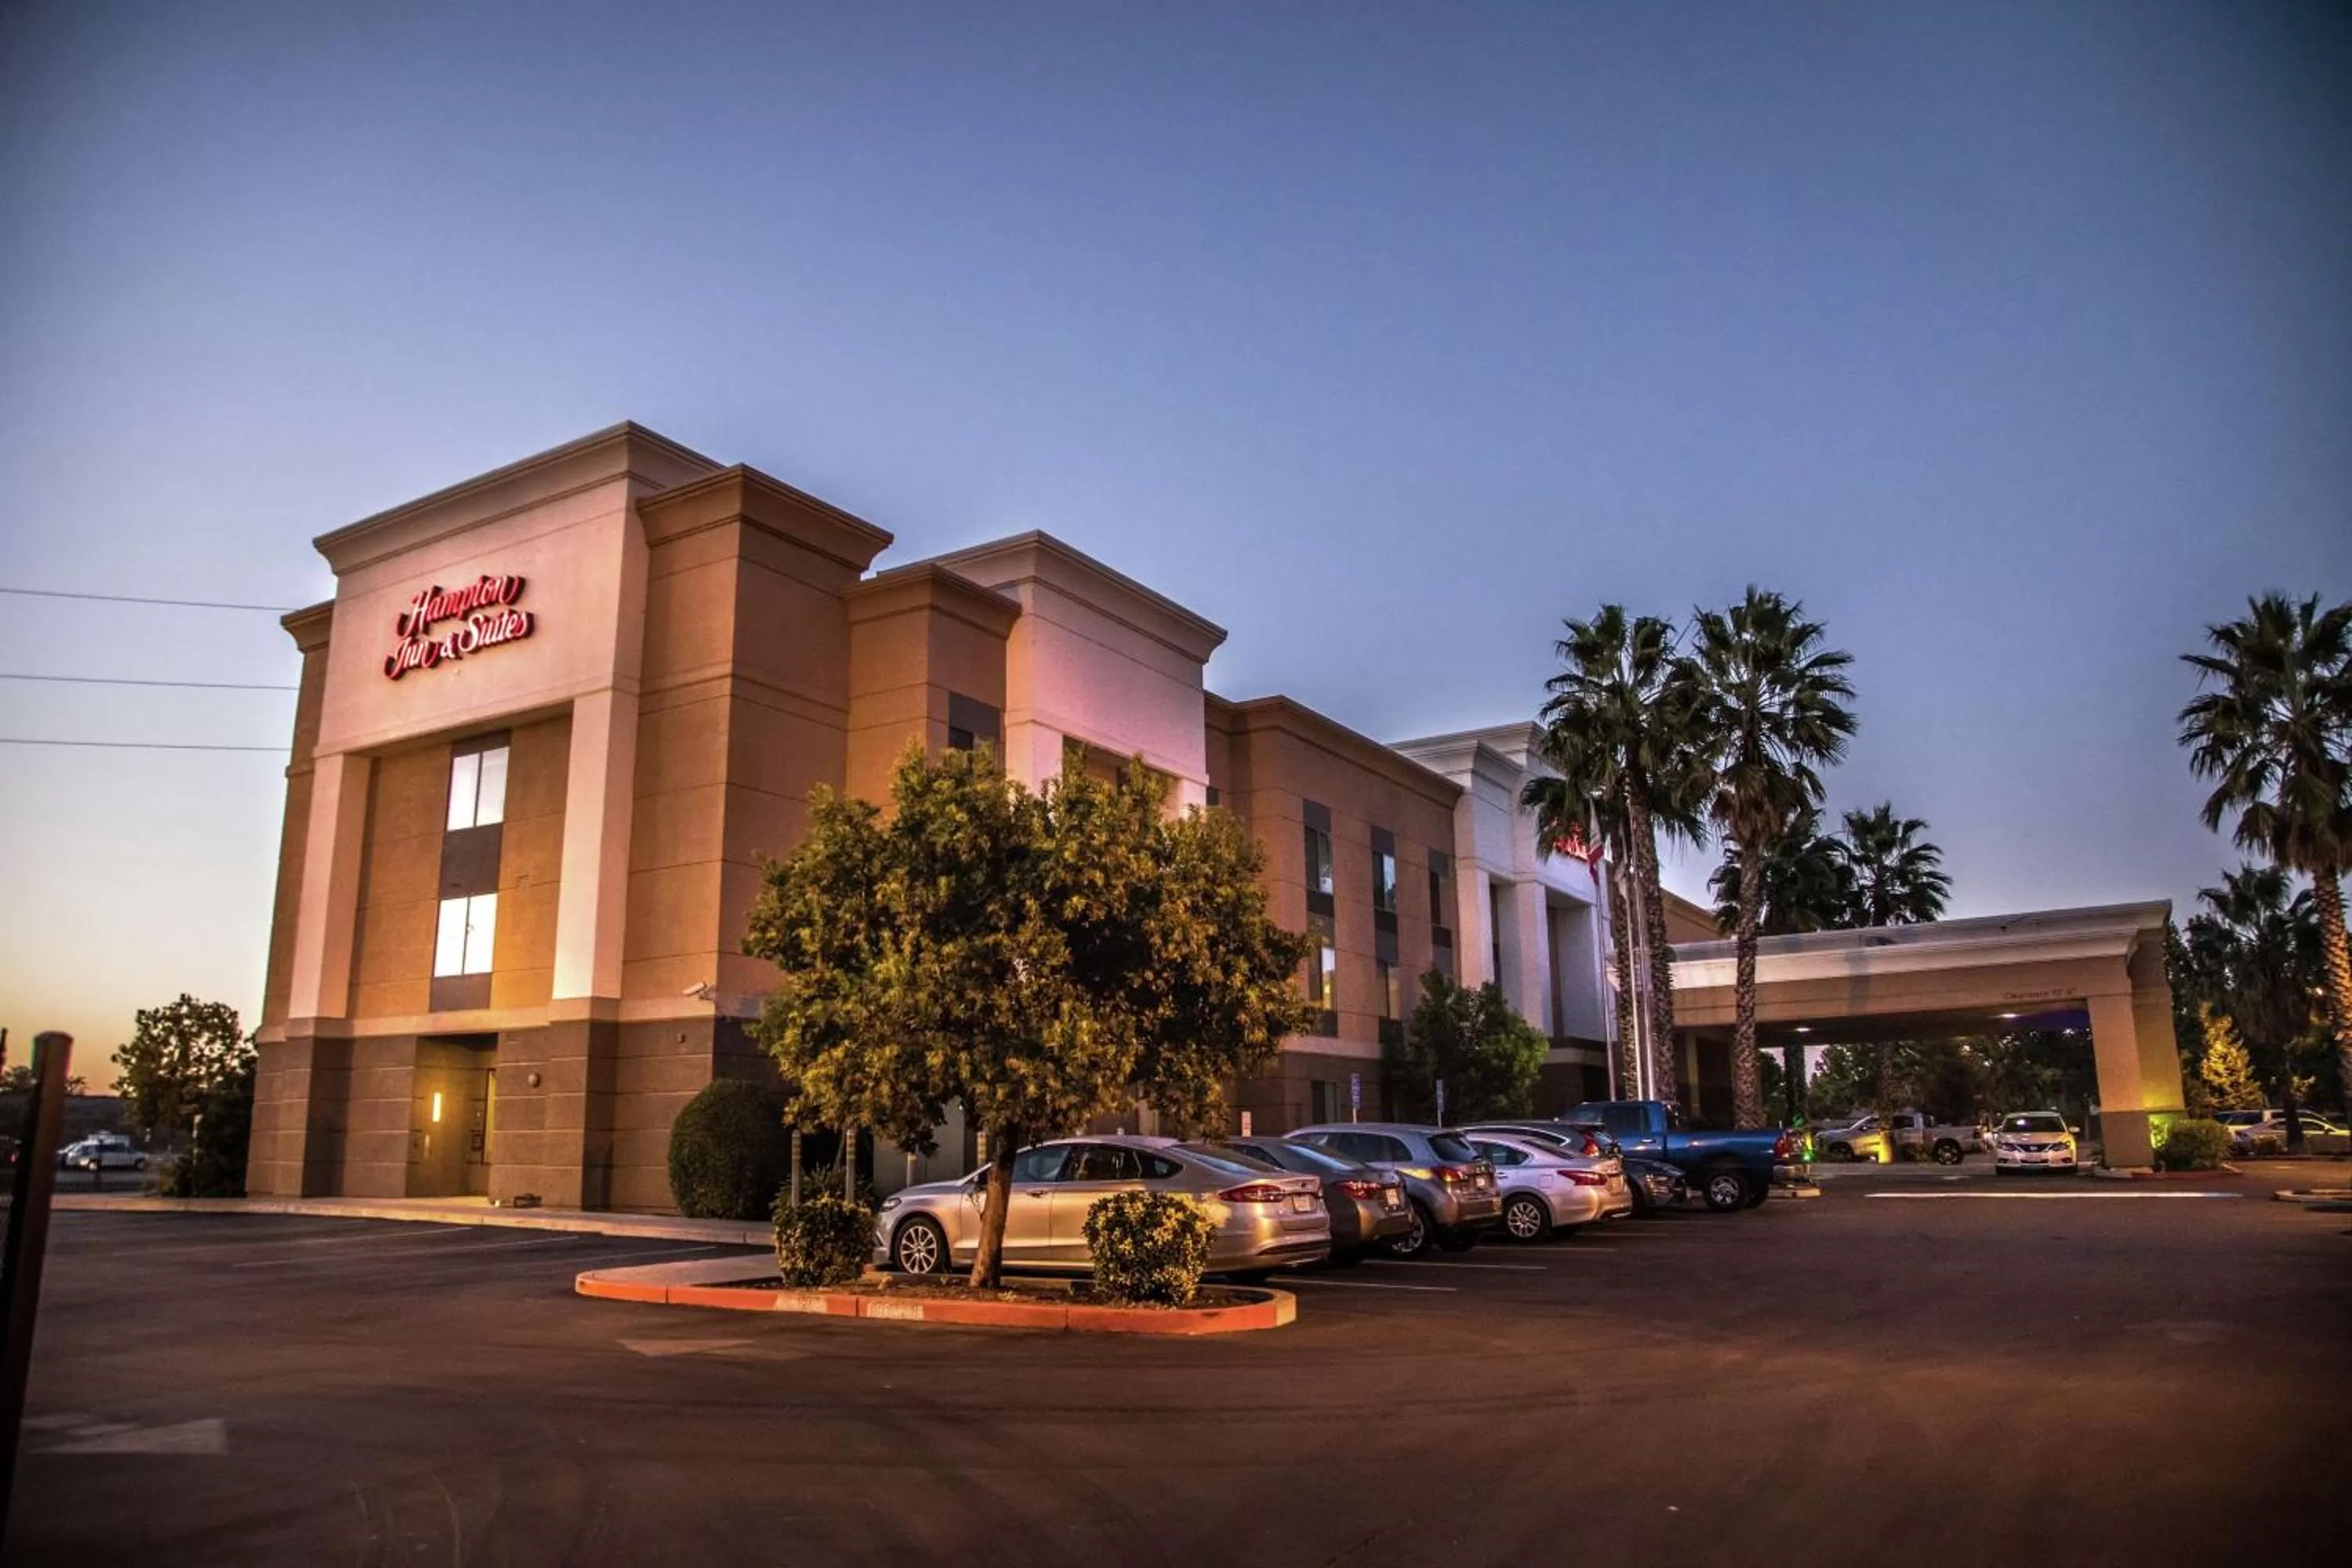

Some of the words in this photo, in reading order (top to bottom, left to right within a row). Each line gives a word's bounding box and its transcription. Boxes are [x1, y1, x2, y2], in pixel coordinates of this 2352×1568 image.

[398, 575, 525, 637] Hampton
[385, 637, 442, 680] Inn
[440, 631, 460, 659] &
[458, 609, 534, 653] Suites
